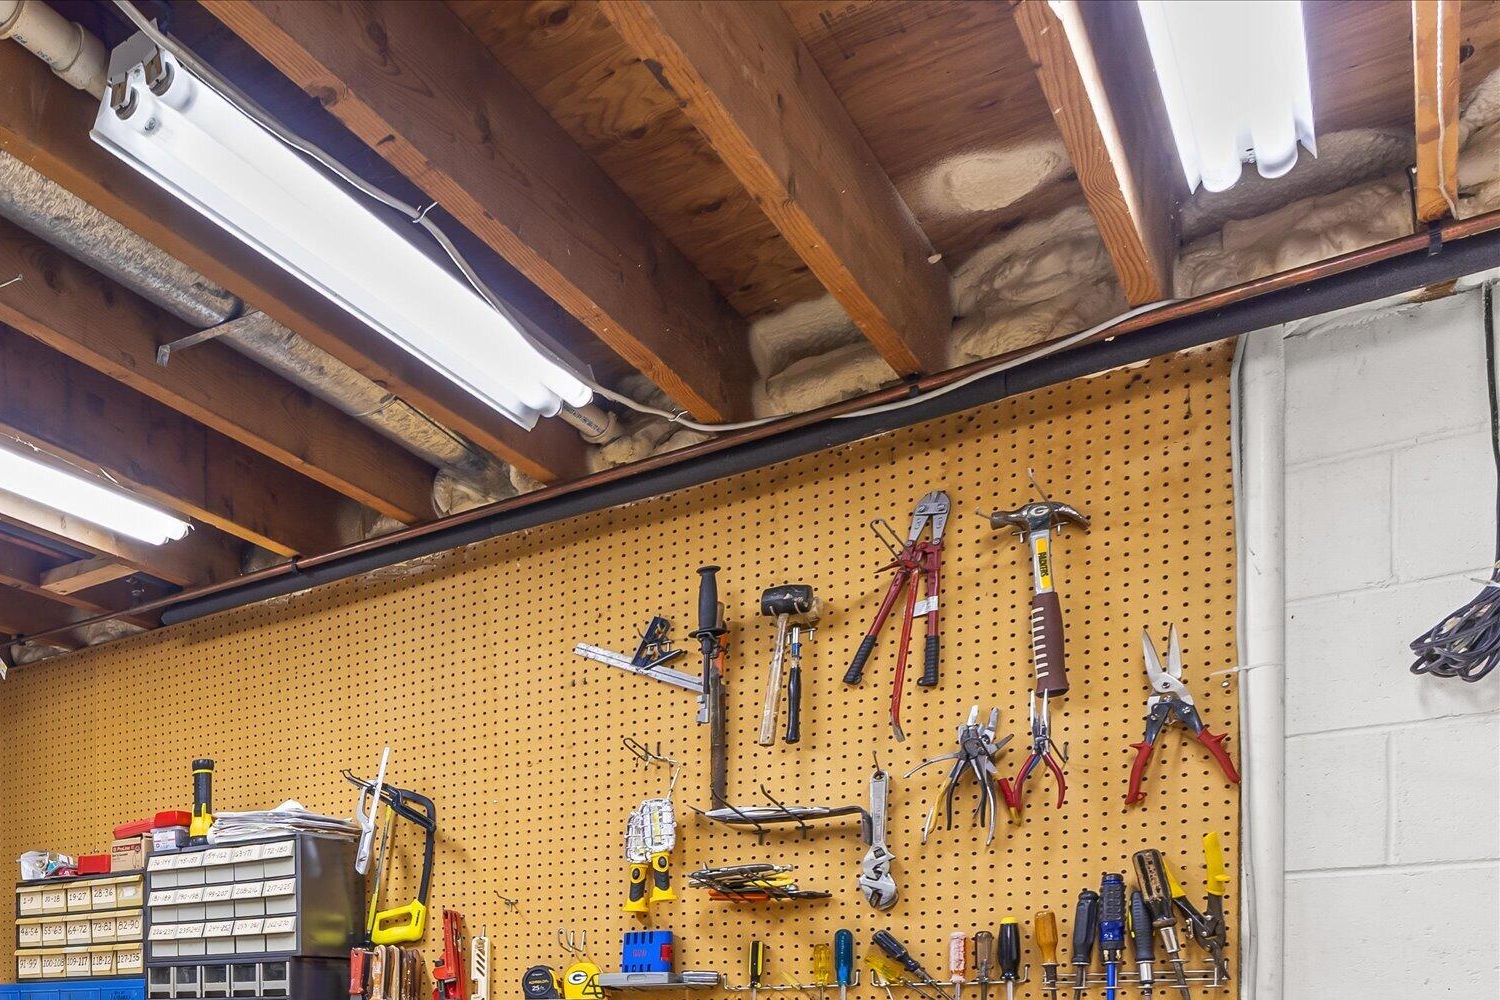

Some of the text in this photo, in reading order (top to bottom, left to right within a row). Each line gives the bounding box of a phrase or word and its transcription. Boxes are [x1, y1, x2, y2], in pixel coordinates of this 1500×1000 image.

[69, 892, 87, 901] 19-27
[94, 888, 113, 898] 28-36
[68, 924, 87, 934] 64-72
[93, 922, 113, 932] 73-81
[117, 919, 140, 930] 82-90
[20, 927, 39, 936] 46-54
[44, 925, 62, 935] 55-63
